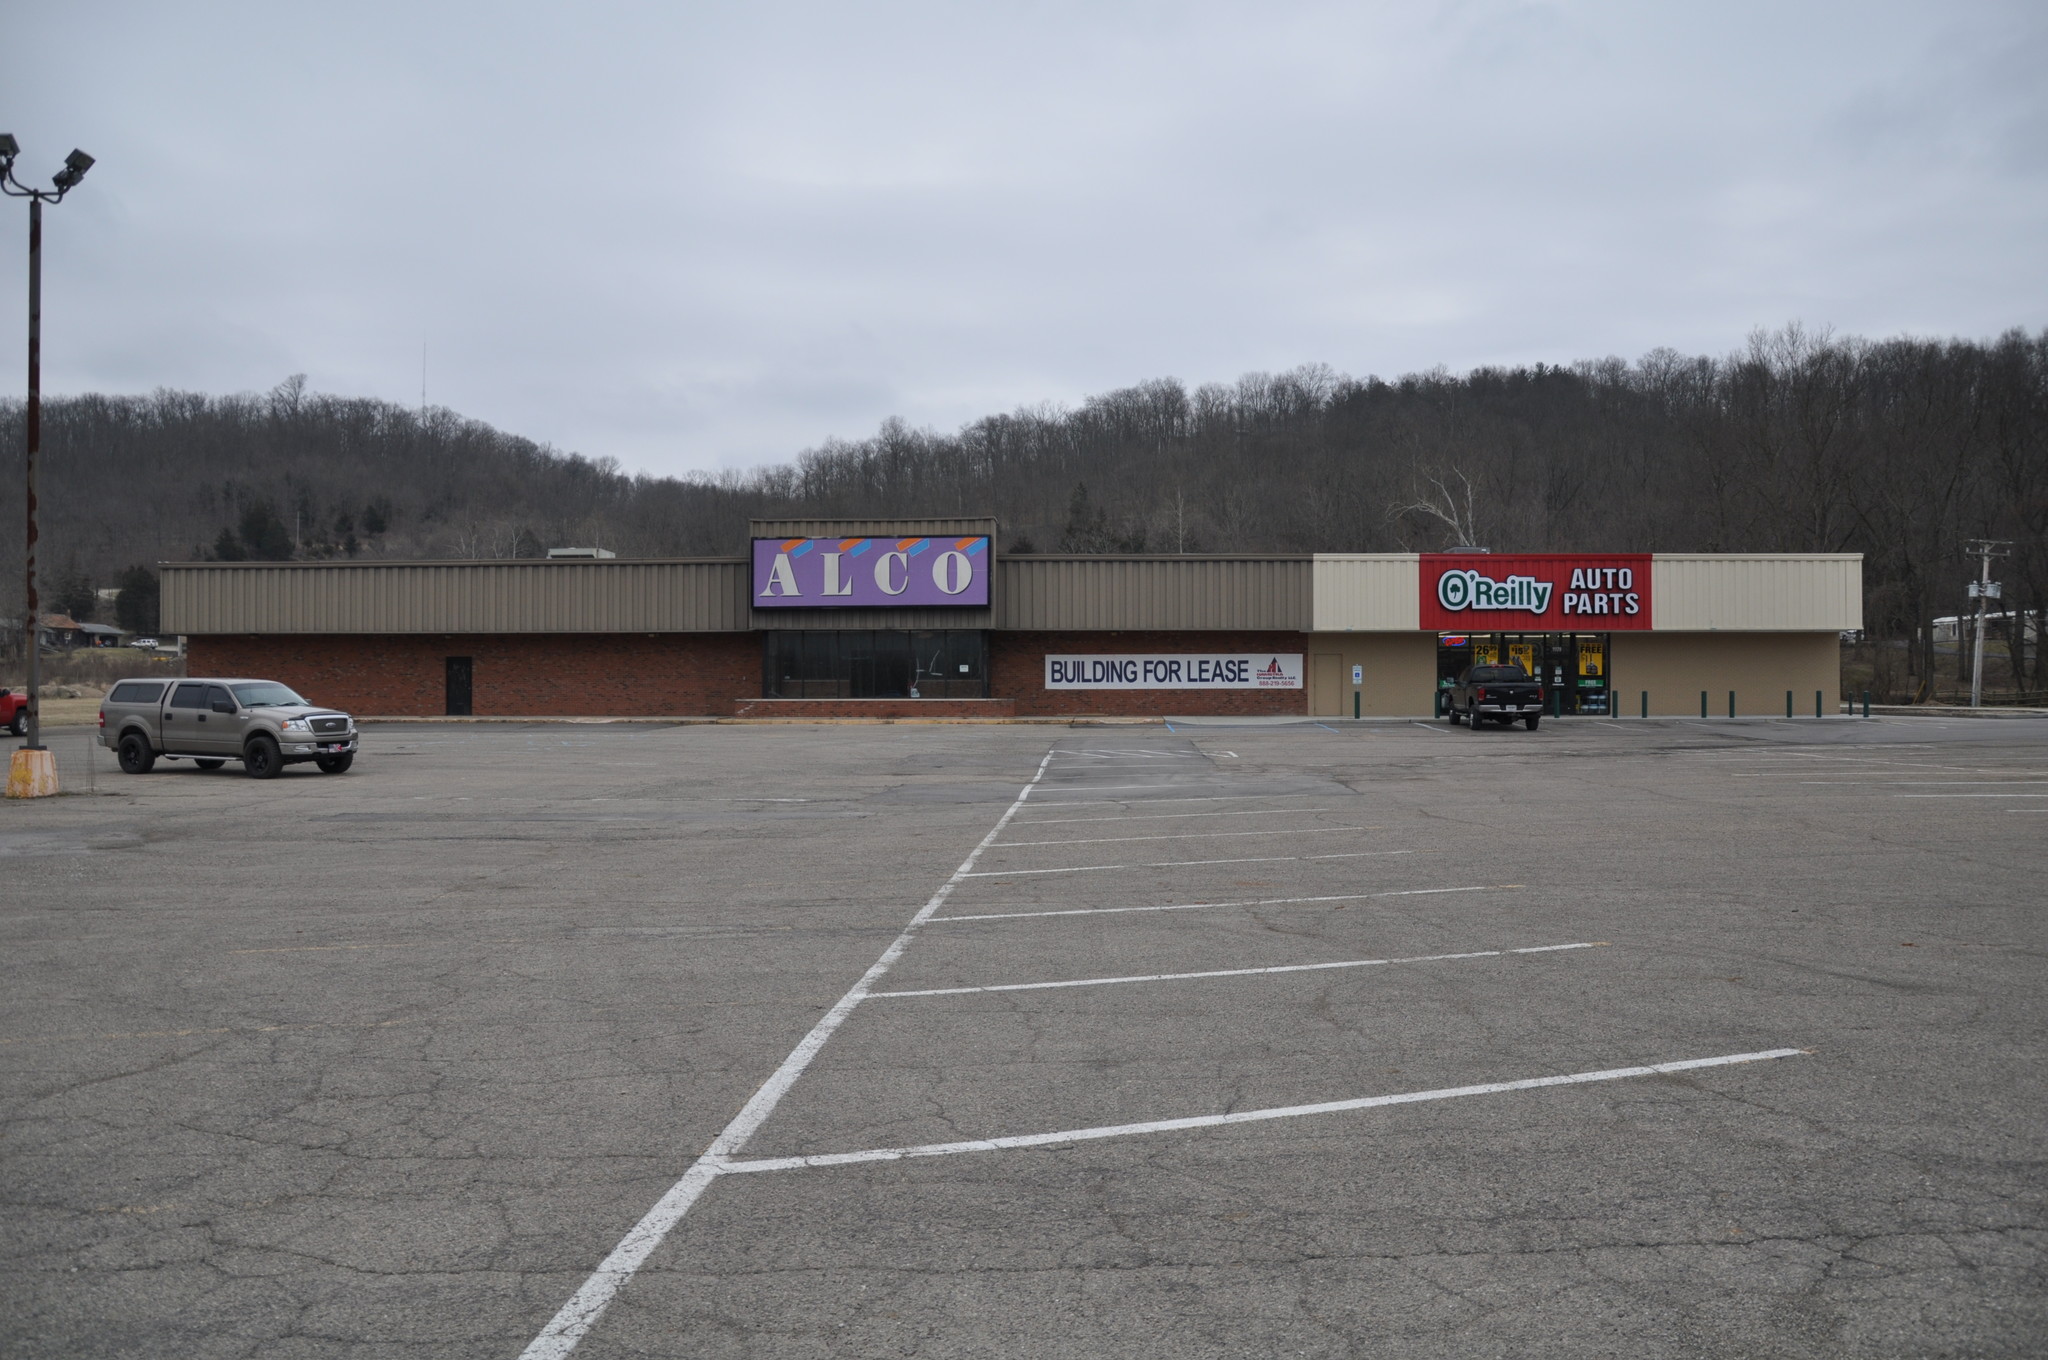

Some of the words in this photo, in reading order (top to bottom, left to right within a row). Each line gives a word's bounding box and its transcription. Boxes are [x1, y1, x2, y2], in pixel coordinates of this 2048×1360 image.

[759, 551, 973, 597] ALCO
[1570, 568, 1633, 590] AUTO
[1440, 571, 1550, 612] O'Reilly
[1563, 593, 1640, 615] PARTS
[1580, 646, 1602, 654] FREE
[1051, 659, 1138, 683] BUILDING
[1143, 659, 1182, 683] FOR
[1187, 659, 1249, 683] LEASE
